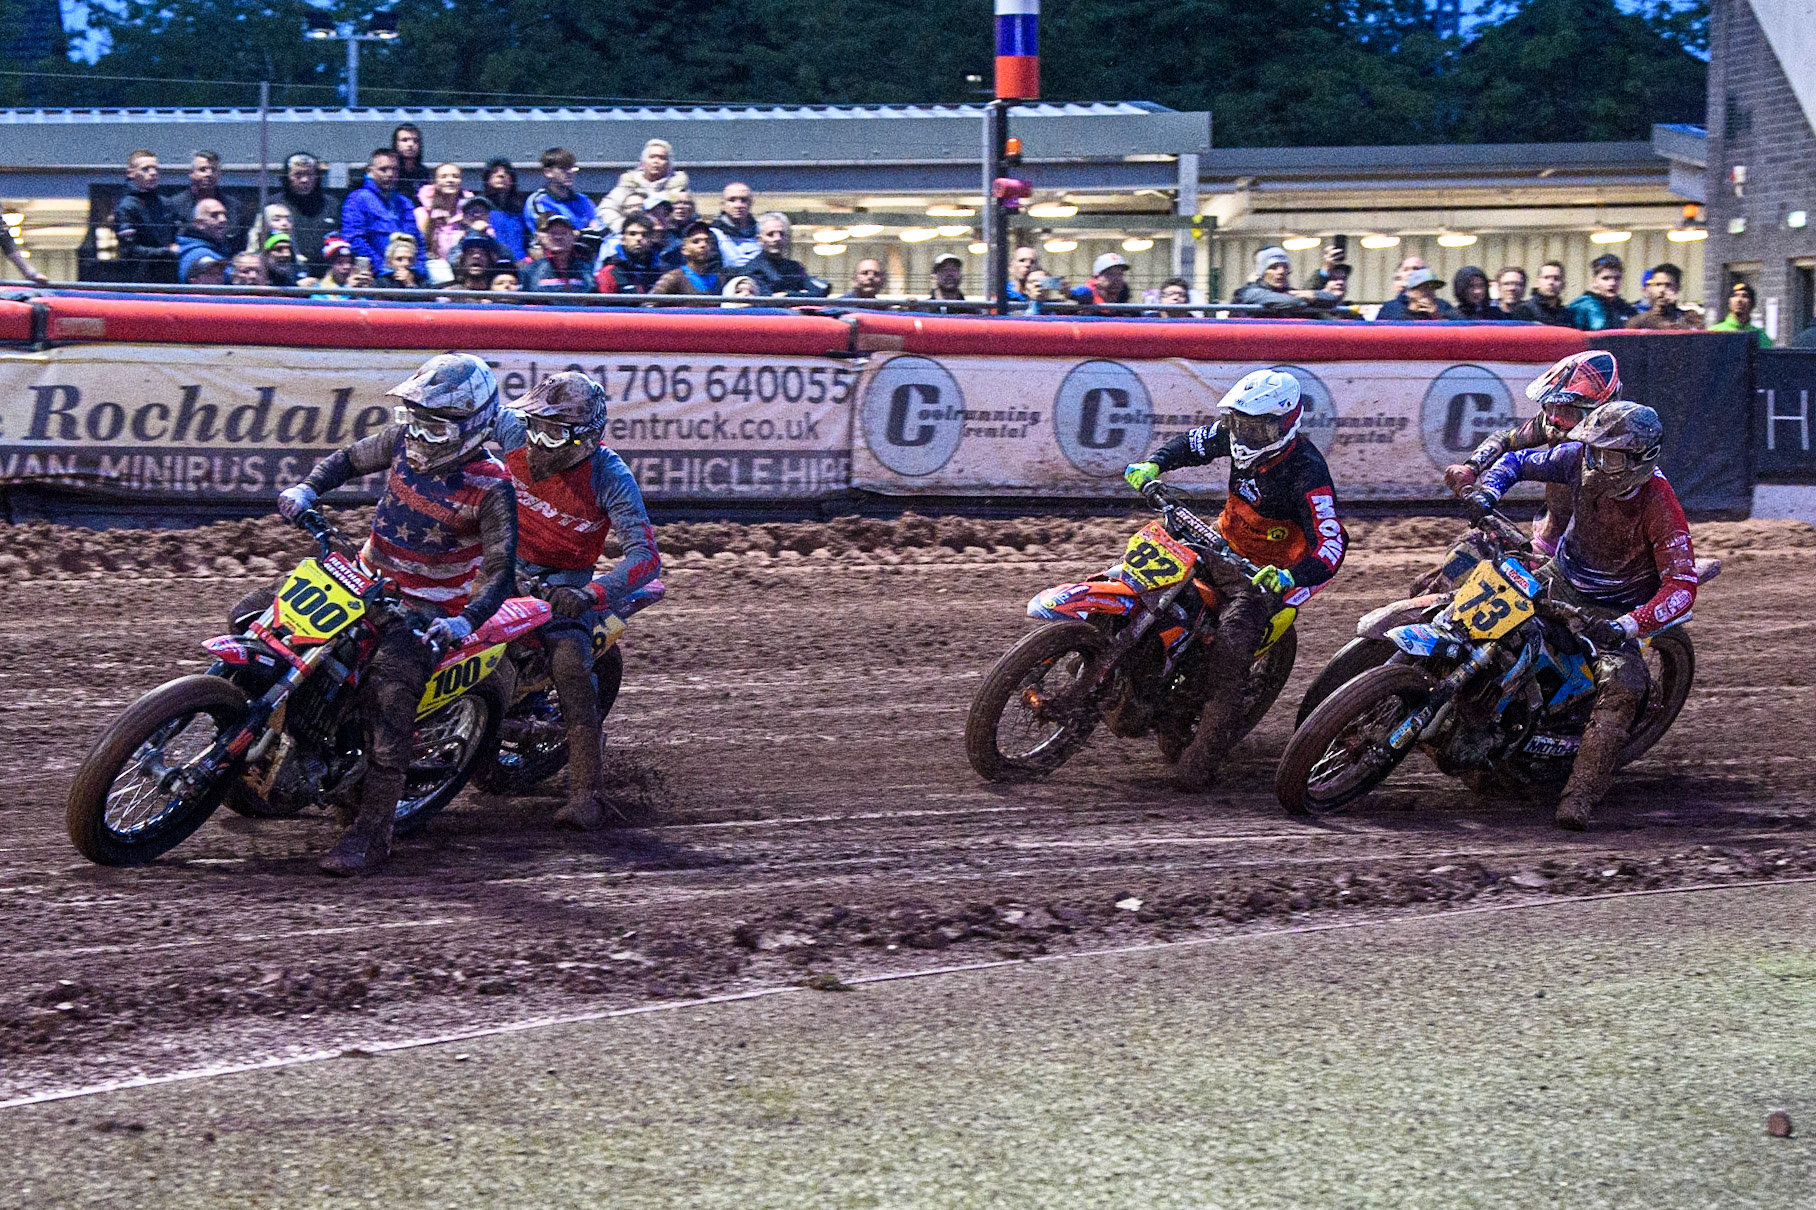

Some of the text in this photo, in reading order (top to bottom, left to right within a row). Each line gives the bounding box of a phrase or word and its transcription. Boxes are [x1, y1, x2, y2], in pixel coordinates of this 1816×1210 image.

[564, 363, 693, 402] 1706
[705, 364, 850, 404] 640055
[24, 385, 391, 443] Rochdale
[606, 412, 820, 441] entruck.co.uk
[328, 556, 366, 588] RENTHAL
[1125, 542, 1180, 586] 82
[281, 575, 348, 633] 100
[1457, 580, 1511, 631] 73
[432, 656, 481, 699] 100
